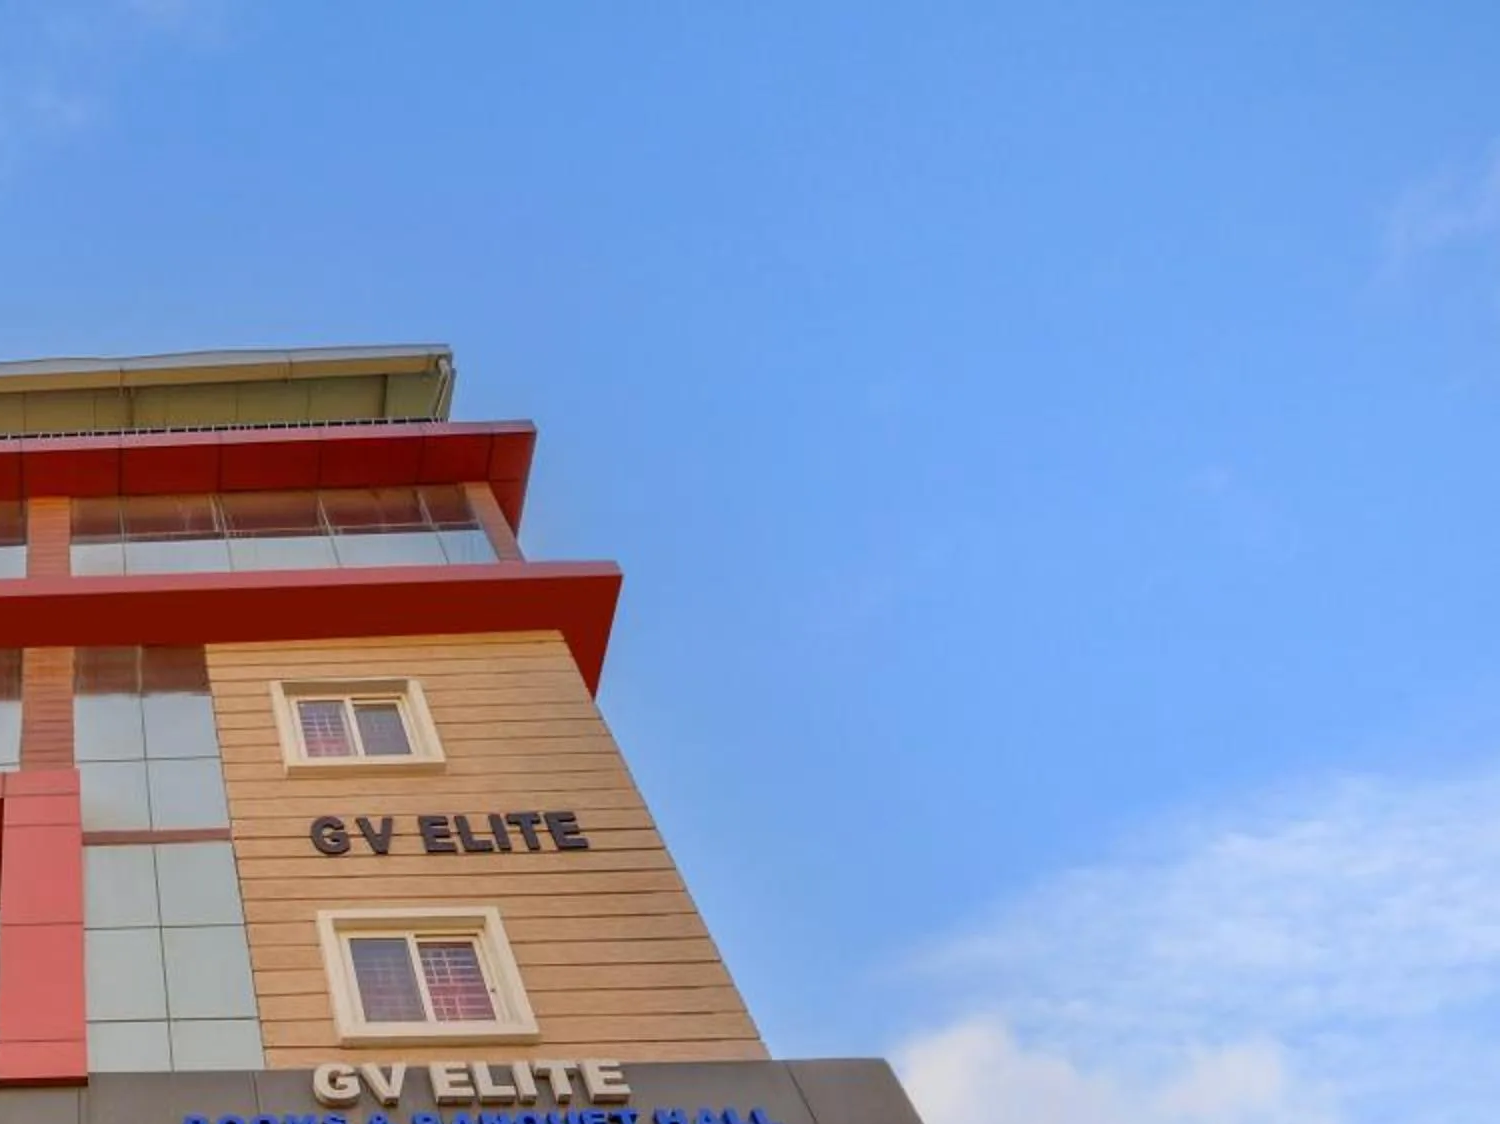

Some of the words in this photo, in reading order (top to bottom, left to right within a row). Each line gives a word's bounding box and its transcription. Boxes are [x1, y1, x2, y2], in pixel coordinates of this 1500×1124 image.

[309, 815, 393, 855] GV
[418, 811, 590, 854] ELITE
[313, 1060, 406, 1106] GV
[430, 1058, 631, 1104] ELITE
